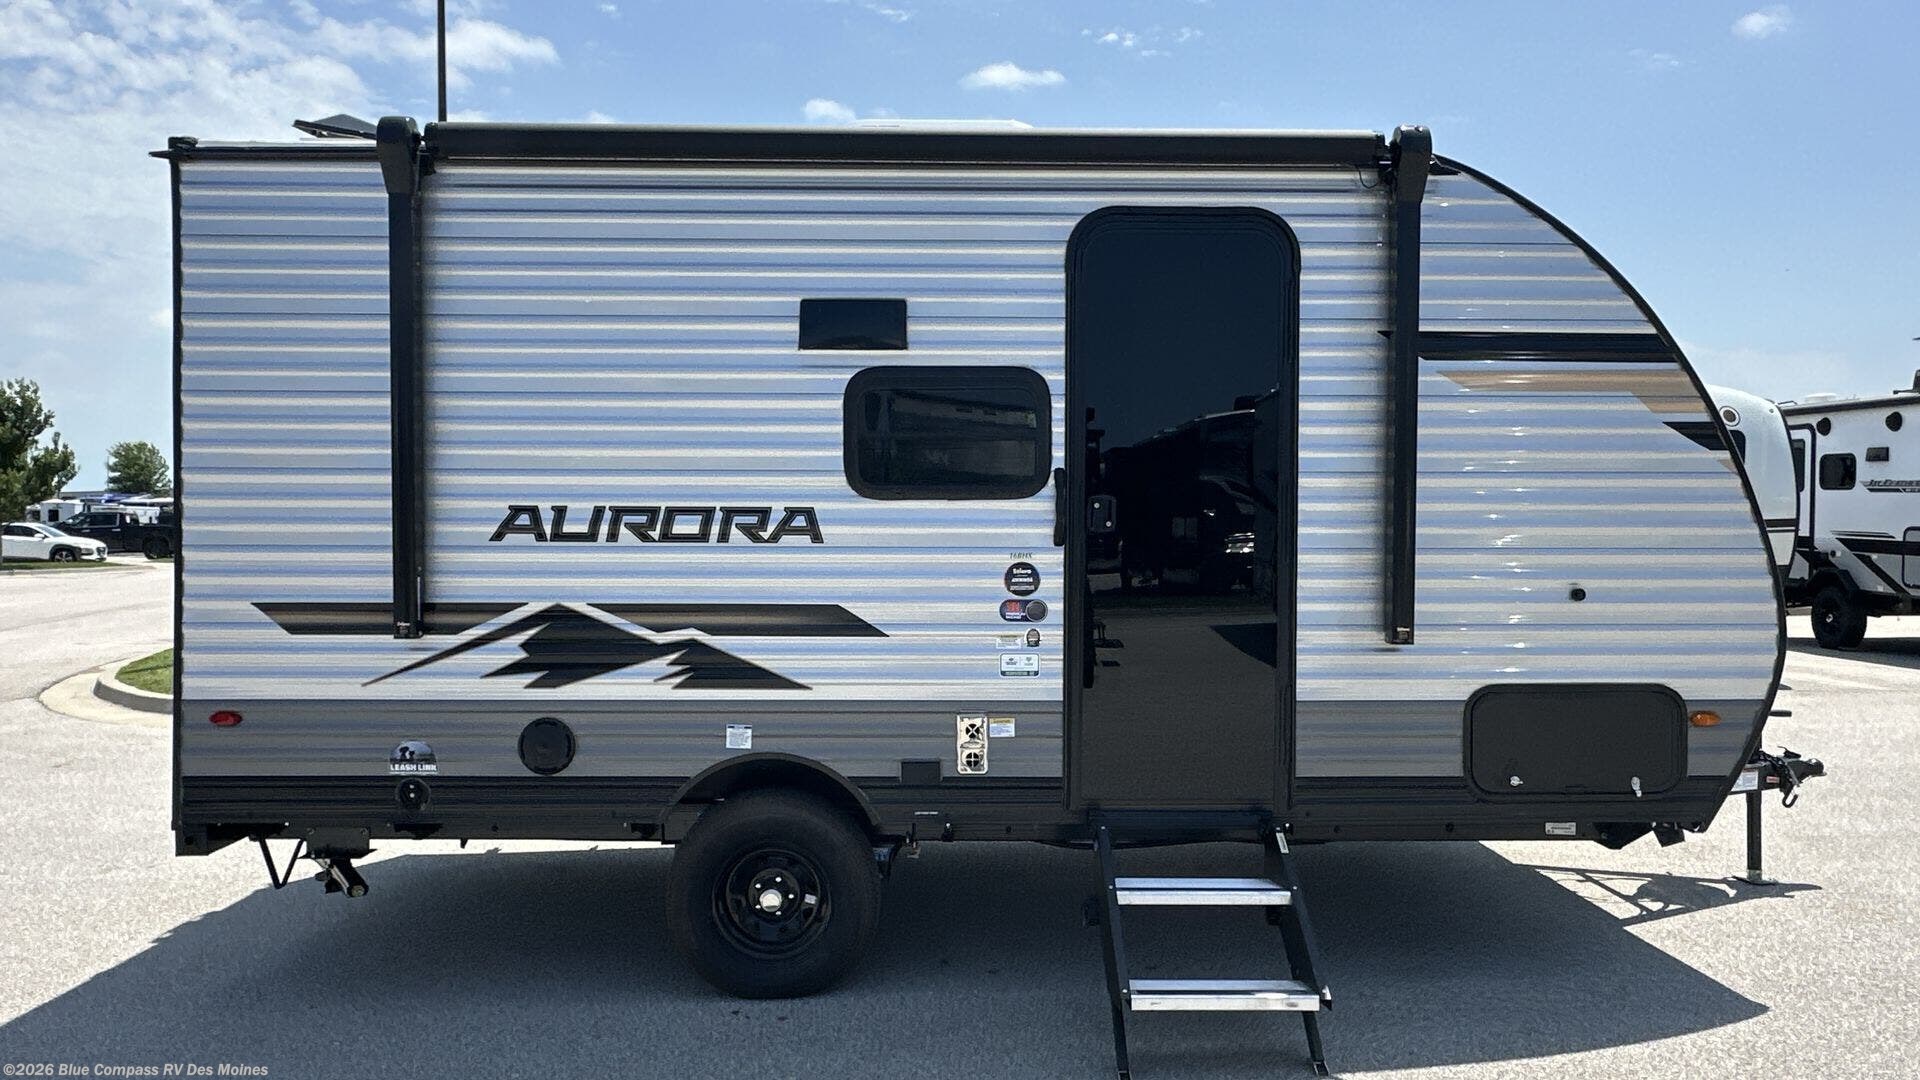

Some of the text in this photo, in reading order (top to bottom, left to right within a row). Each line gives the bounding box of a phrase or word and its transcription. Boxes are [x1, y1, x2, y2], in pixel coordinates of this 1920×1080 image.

[488, 504, 825, 544] AURORA
[390, 763, 437, 771] LEASH LINK
